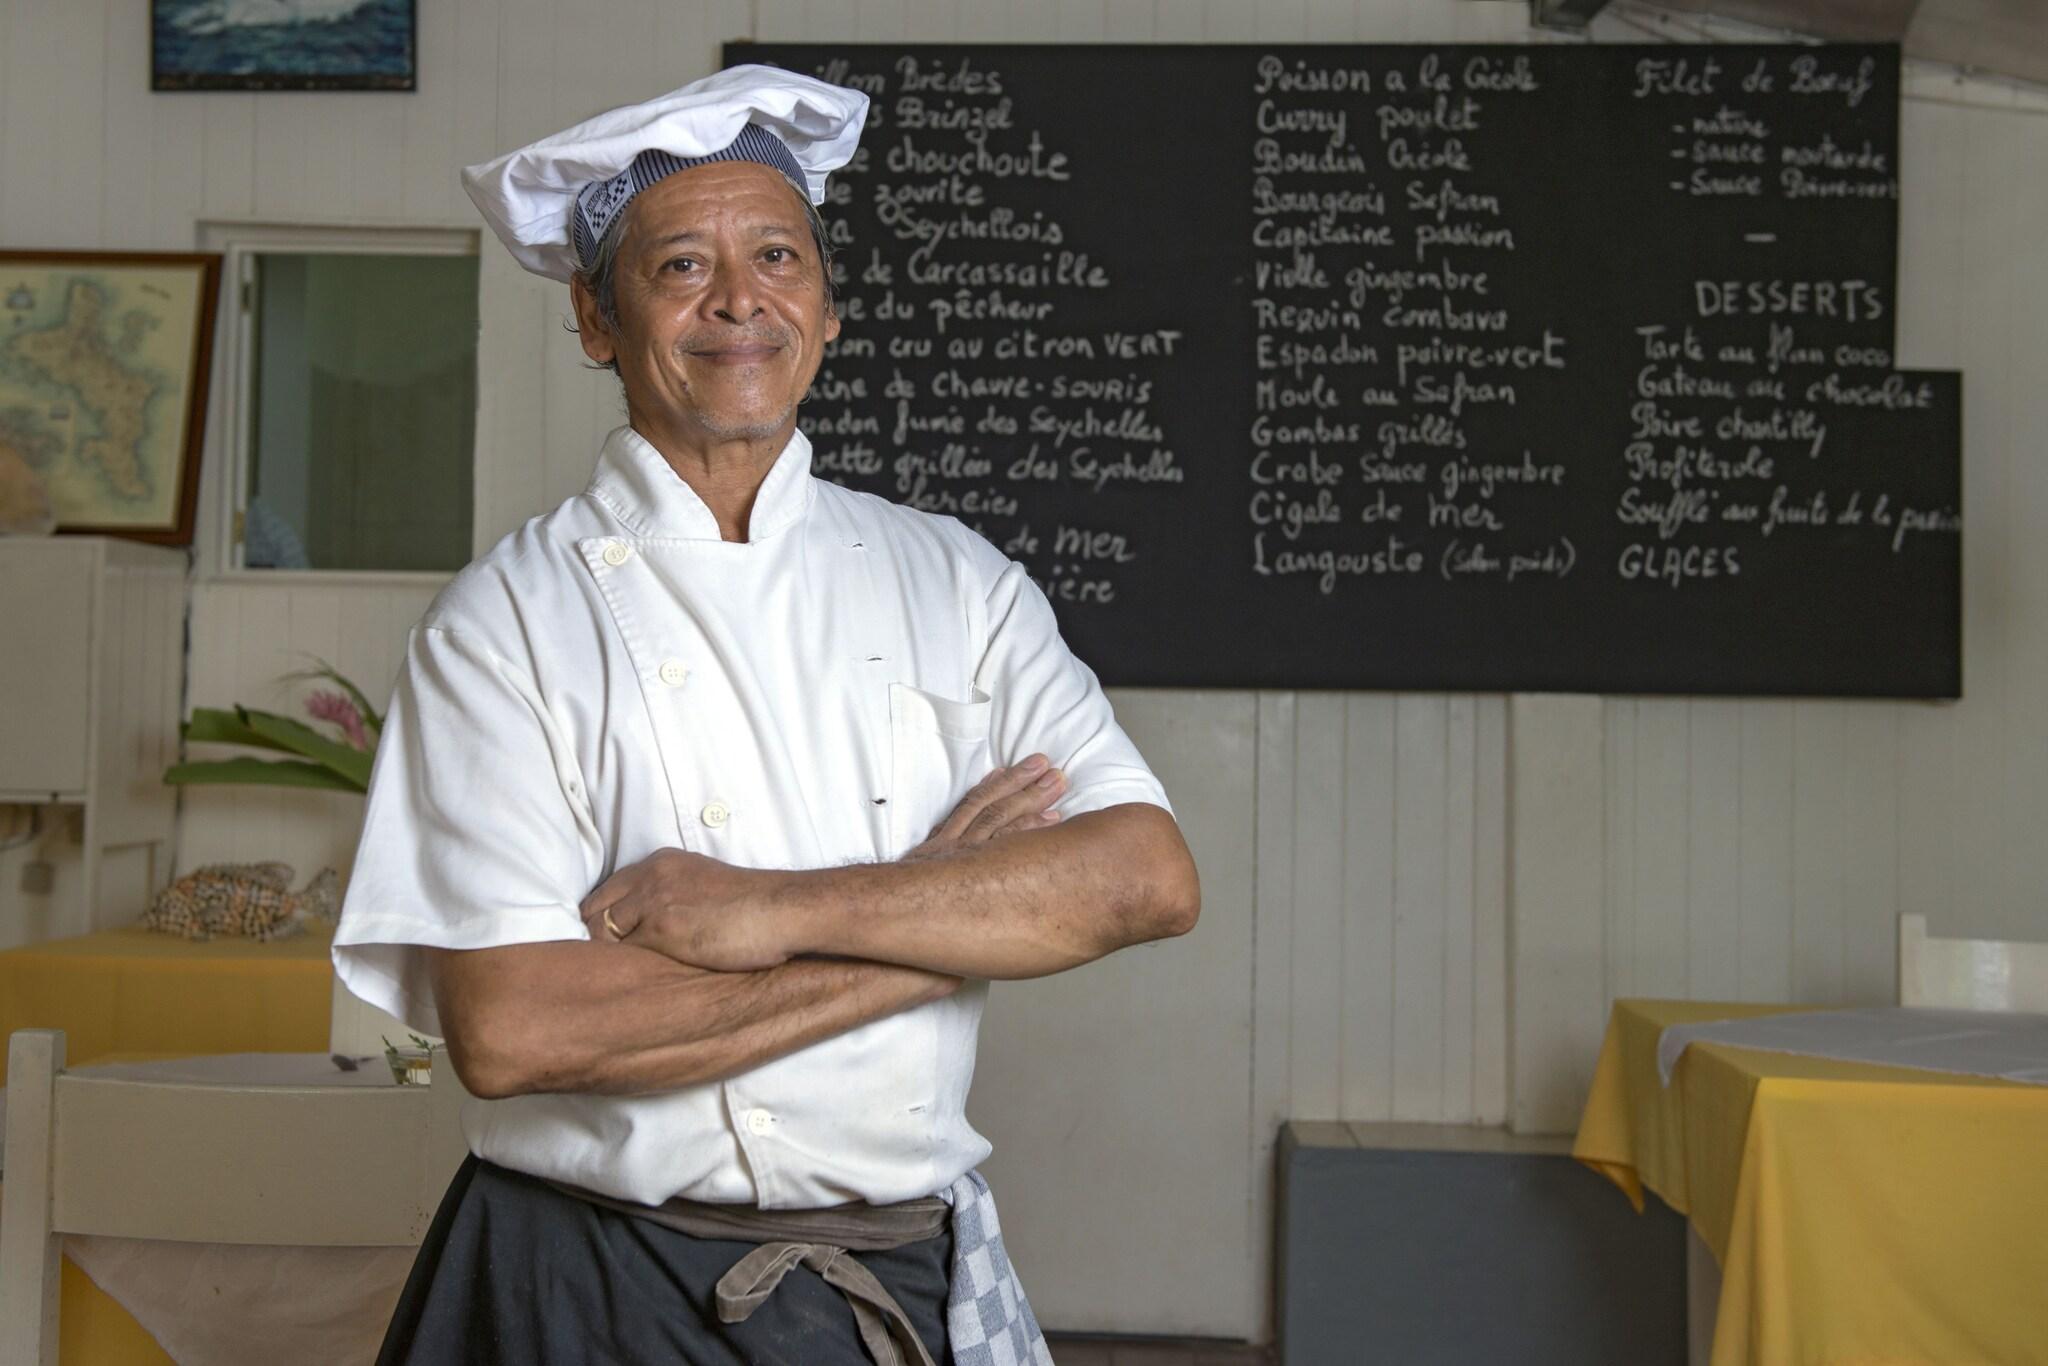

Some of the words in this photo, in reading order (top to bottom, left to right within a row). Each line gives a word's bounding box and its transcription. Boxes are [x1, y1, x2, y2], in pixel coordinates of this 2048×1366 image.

[1418, 53, 1452, 92] la
[1633, 57, 1722, 99] Filet
[1741, 56, 1774, 93] de
[1256, 98, 1347, 149] Curry
[1376, 93, 1481, 141] poulet
[886, 130, 1072, 180] chouchoute
[1253, 137, 1366, 174] Boudin
[894, 206, 1063, 257] Seychellois
[1252, 214, 1395, 259] Capitaine
[861, 247, 893, 285] de
[907, 246, 1110, 287] Carcassaille
[1344, 256, 1489, 309] gingembre
[875, 290, 915, 320] du
[928, 288, 1054, 334] pêcheur
[1251, 296, 1361, 333] Requin
[1695, 279, 1884, 322] DESSERTS
[888, 335, 933, 359] cru
[947, 337, 984, 360] au
[994, 329, 1094, 360] citron
[1103, 331, 1182, 360] VERT
[1256, 332, 1379, 381] Espadon
[1635, 324, 1704, 362] Tarte
[1717, 344, 1756, 364] au
[1834, 343, 1891, 367] coco
[1256, 372, 1340, 412] Moule
[1361, 386, 1400, 407] au
[1746, 379, 1786, 401] au
[1804, 372, 1934, 408] chocolat
[976, 404, 1018, 435] des
[1250, 413, 1361, 447] Gambas
[1630, 401, 1703, 440] Poire
[1250, 449, 1345, 485] Crabe
[1361, 488, 1403, 523] de
[1254, 530, 1425, 595] Langouste
[1617, 544, 1741, 588] GLACES
